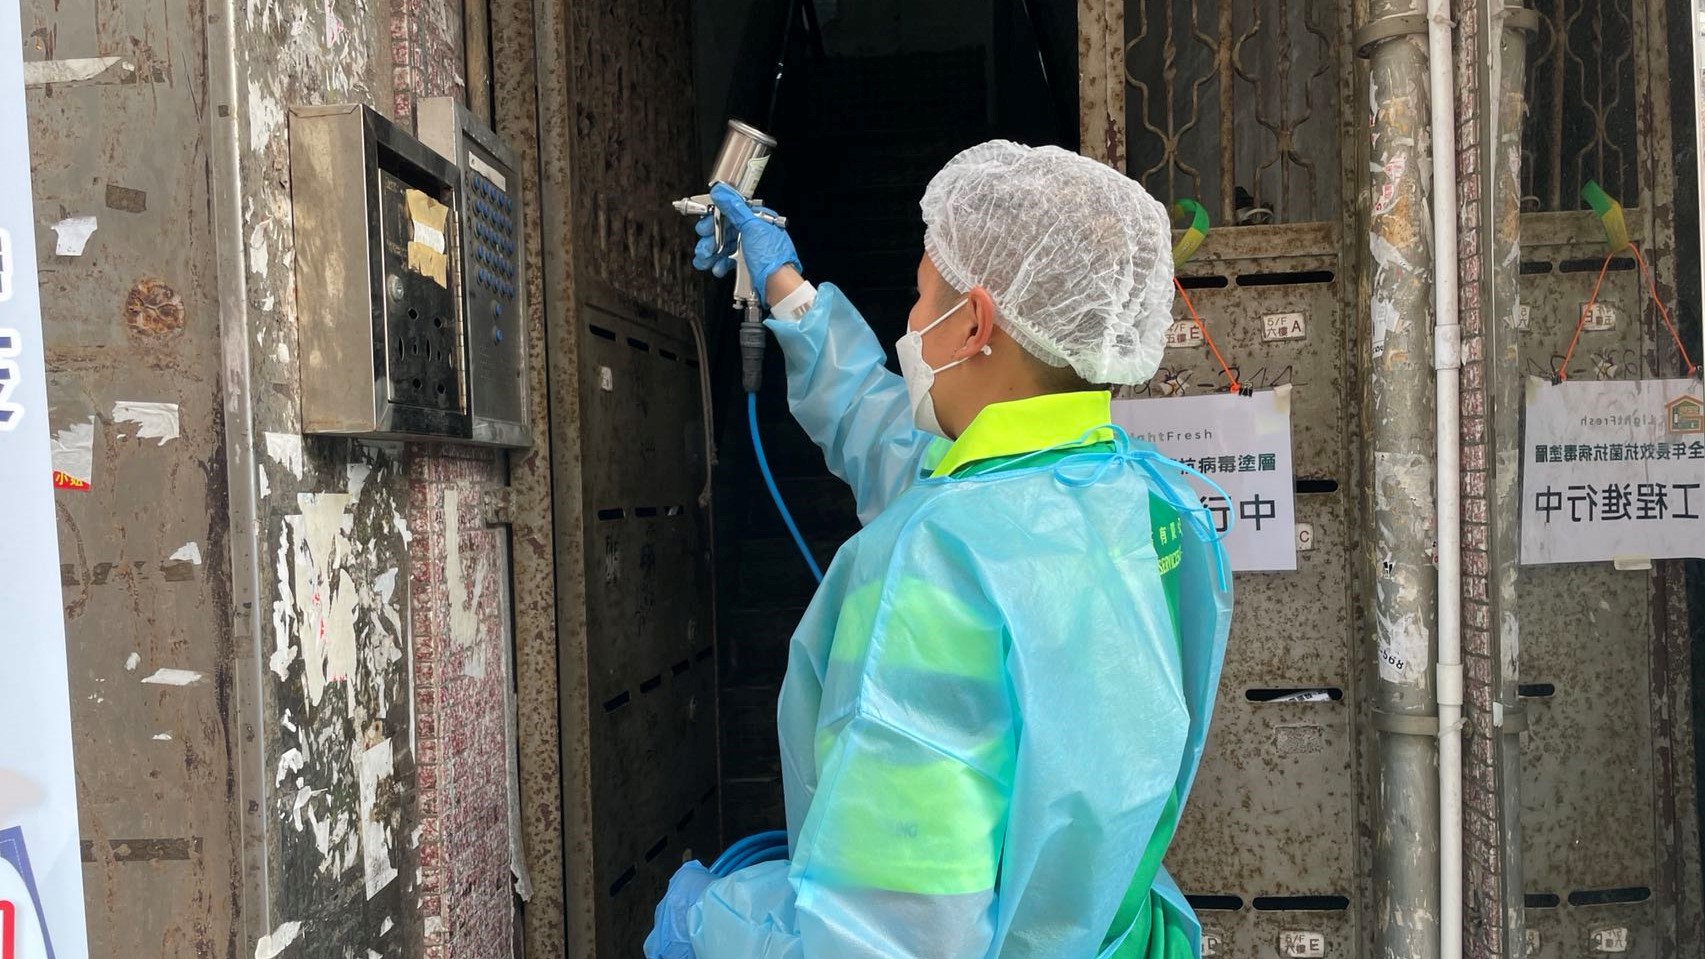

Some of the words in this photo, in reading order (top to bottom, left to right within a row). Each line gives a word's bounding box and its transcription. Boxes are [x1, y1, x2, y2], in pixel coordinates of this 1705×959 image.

[1267, 316, 1287, 326] 5/F
[1291, 320, 1302, 333] A
[1190, 326, 1200, 340] E
[1266, 326, 1289, 337] 六樓
[1299, 530, 1310, 543] C
[1309, 938, 1320, 951] E
